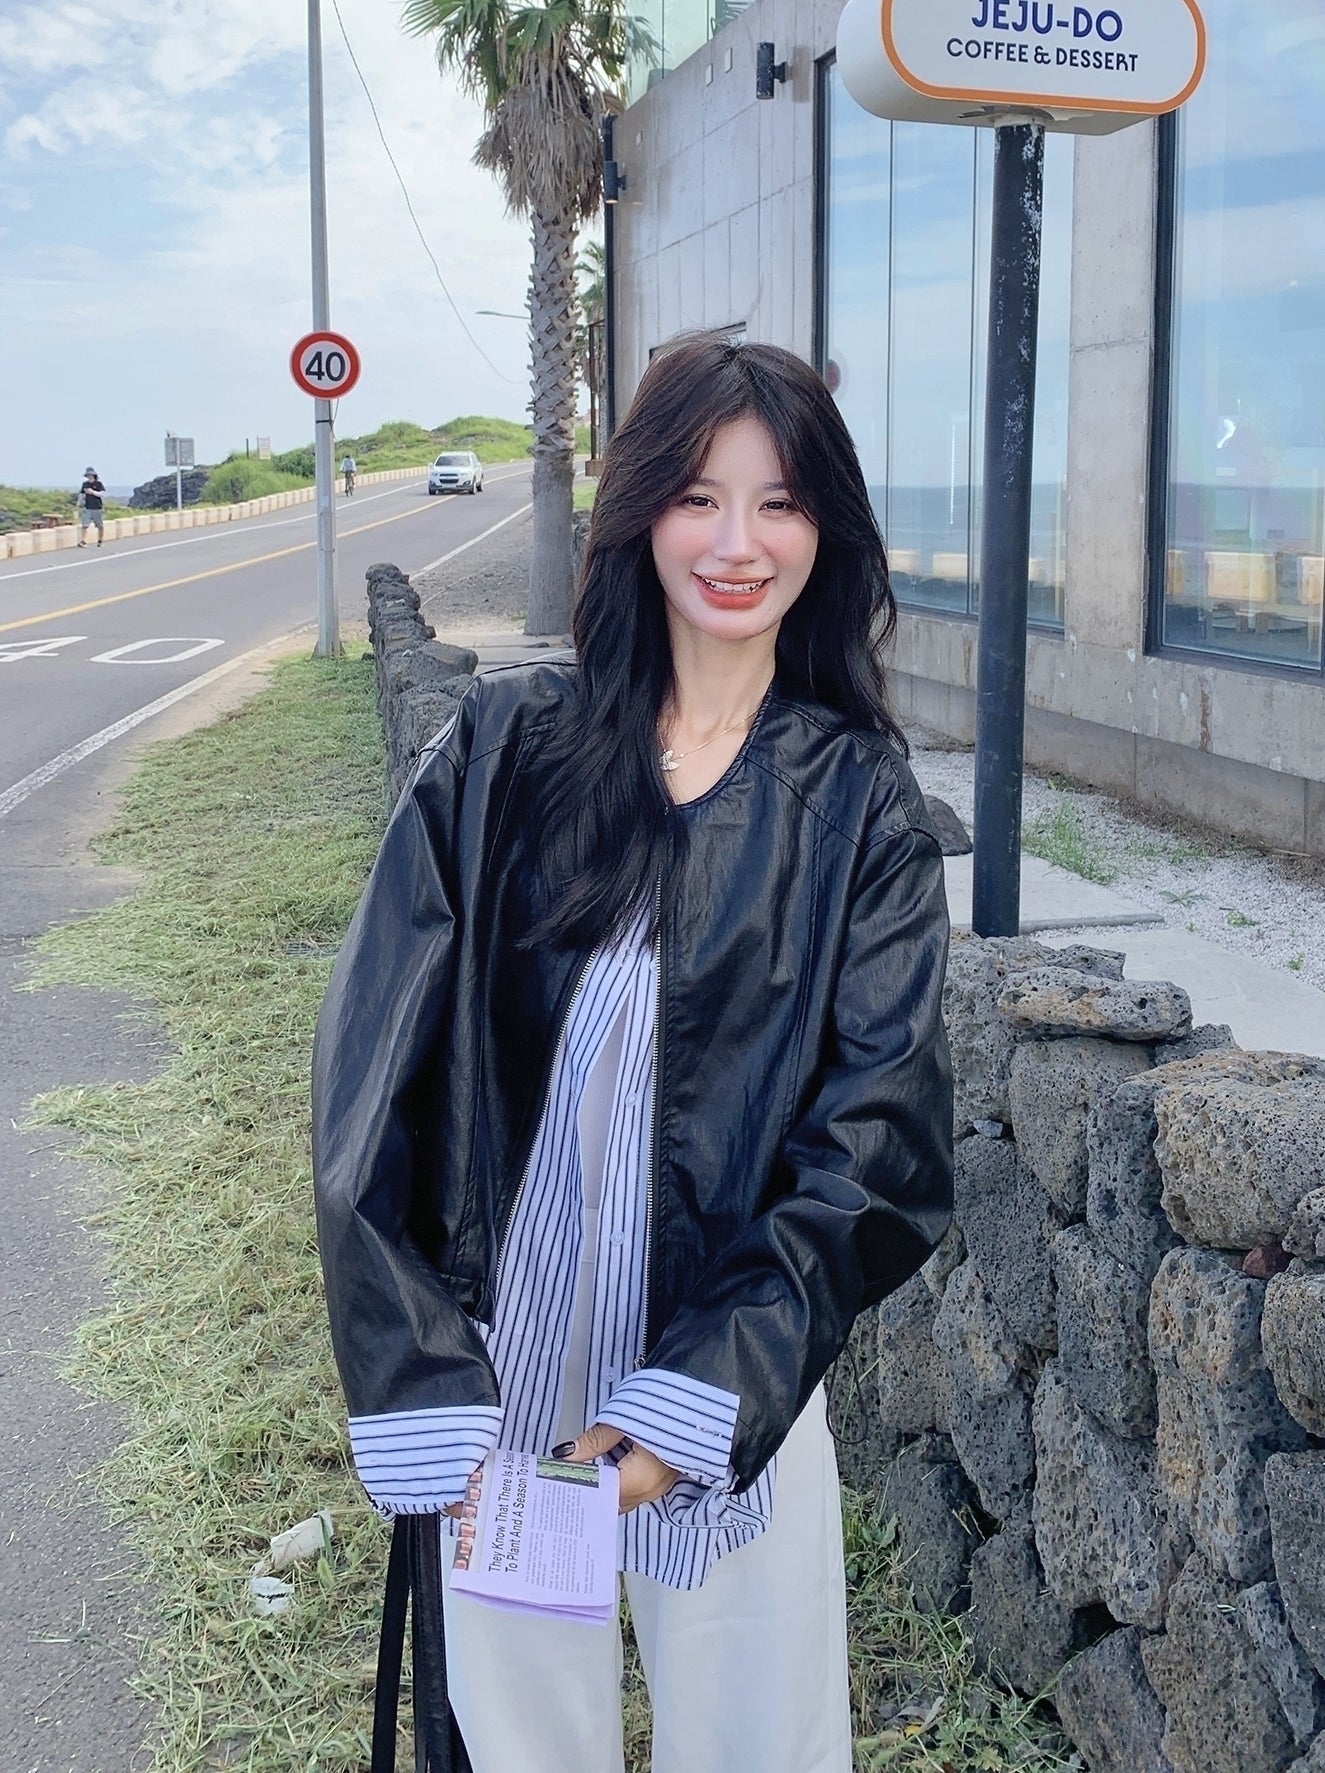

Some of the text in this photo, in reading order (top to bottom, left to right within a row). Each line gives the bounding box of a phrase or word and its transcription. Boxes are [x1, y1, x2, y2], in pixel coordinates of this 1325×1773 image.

[971, 0, 1123, 42] JEJU-DO
[946, 38, 1139, 72] COFFEE & DESSERT
[305, 350, 346, 382] 40
[497, 1478, 512, 1502] There
[512, 1477, 528, 1509] Season
[495, 1504, 509, 1523] That
[513, 1510, 524, 1518] A
[491, 1524, 507, 1550] Know
[511, 1518, 523, 1539] And
[488, 1551, 505, 1572] They
[507, 1538, 521, 1562] Plant
[504, 1562, 518, 1573] To
